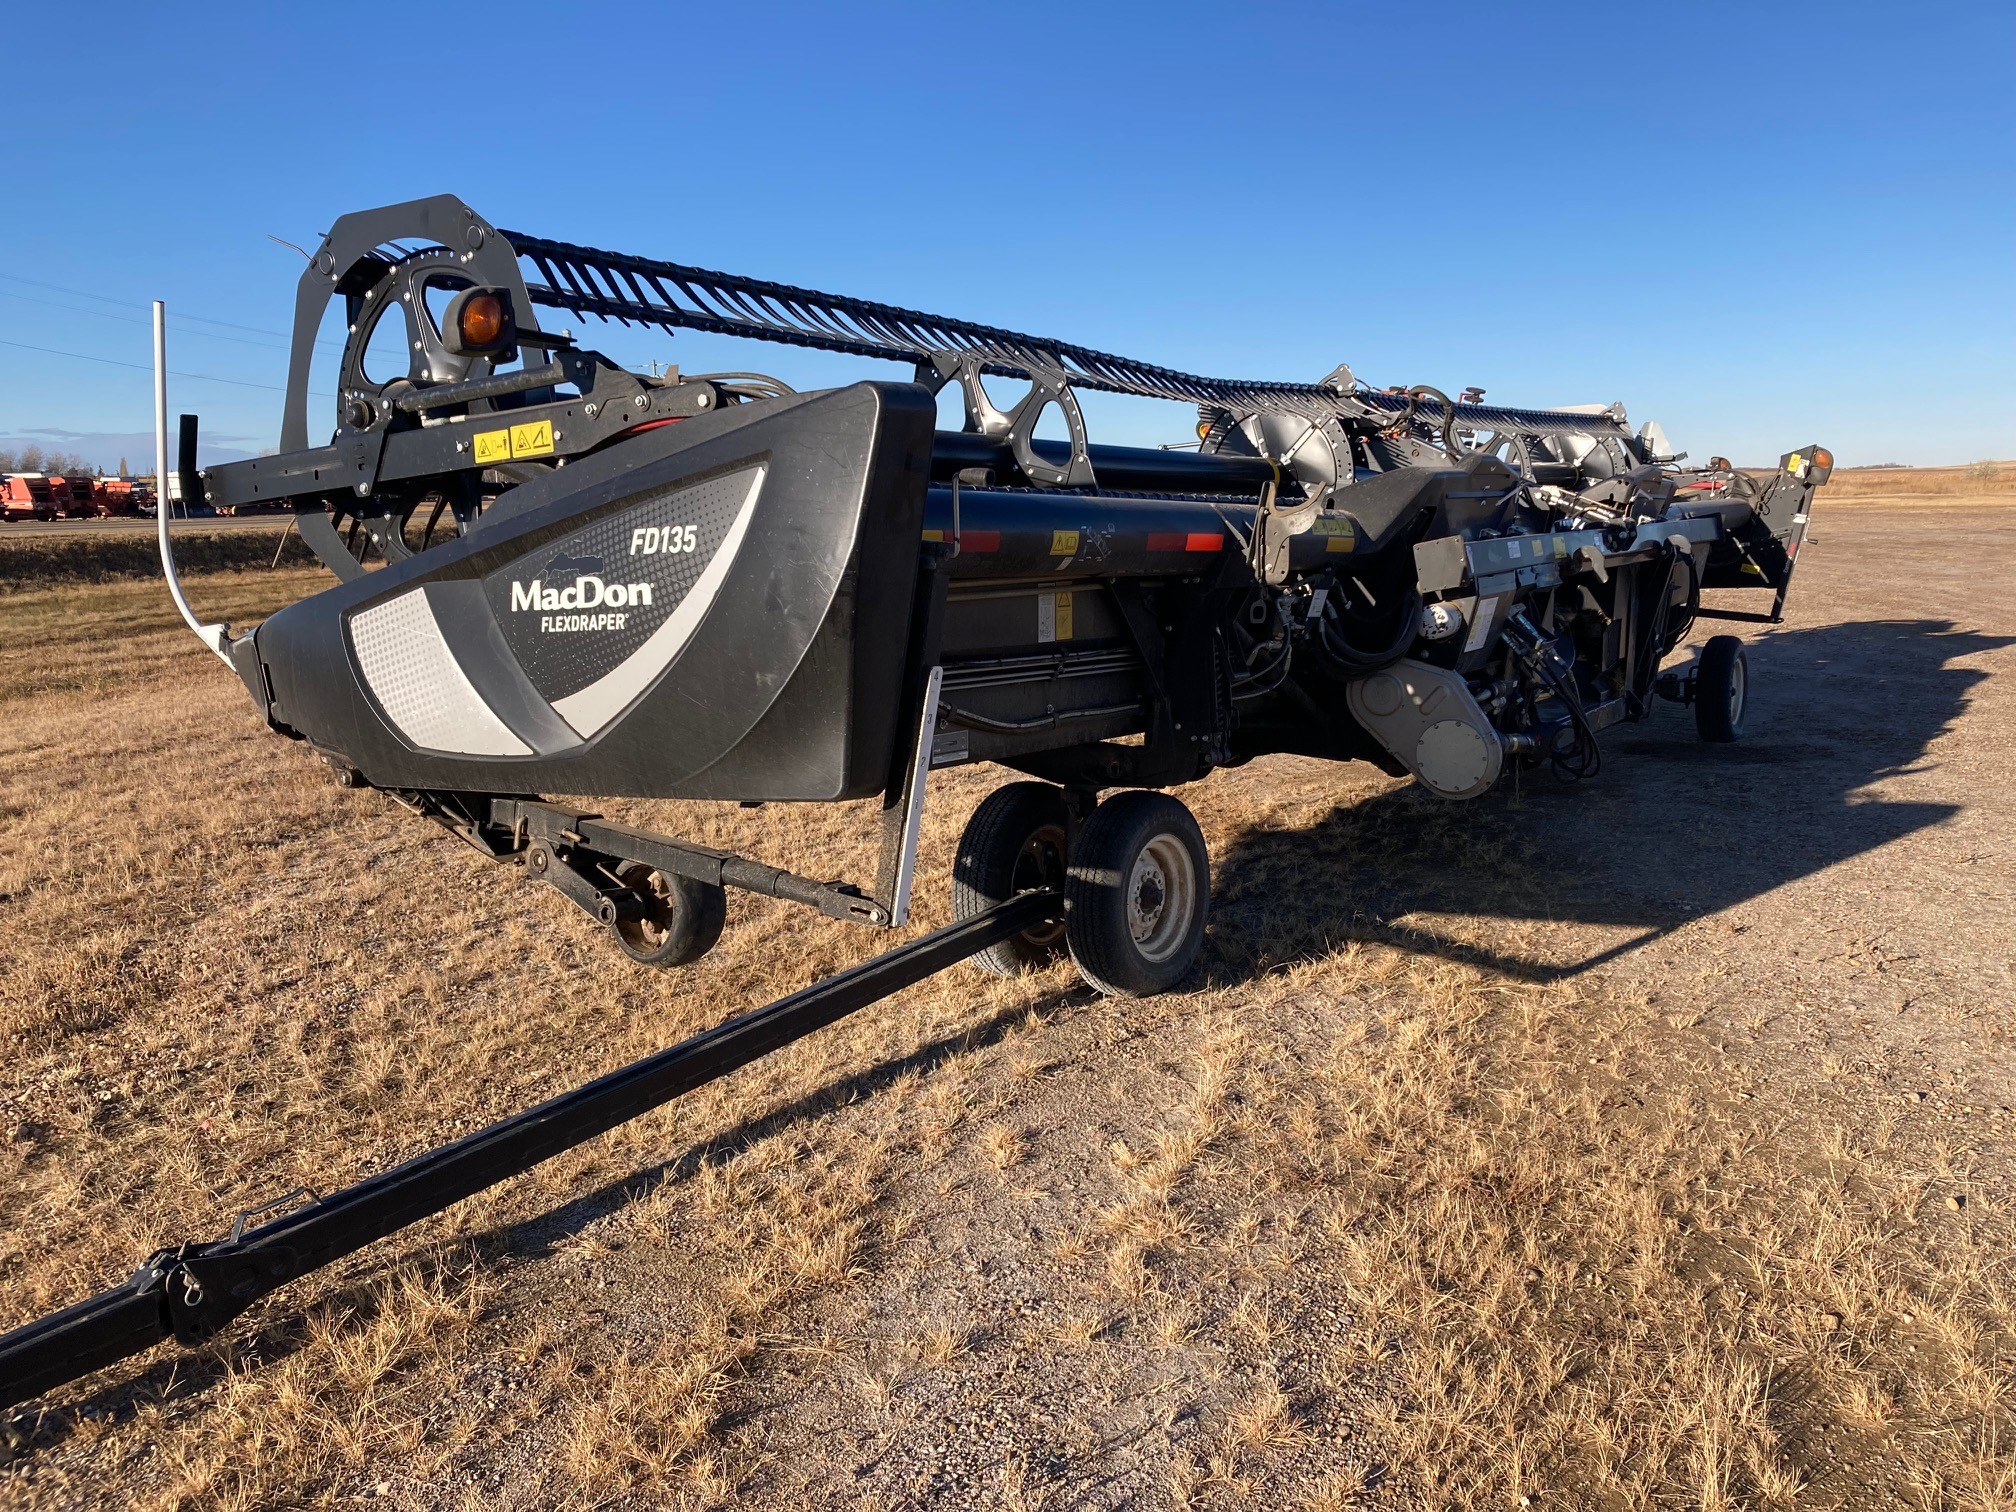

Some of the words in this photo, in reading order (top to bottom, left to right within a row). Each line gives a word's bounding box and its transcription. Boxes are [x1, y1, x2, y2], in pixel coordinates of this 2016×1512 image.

[630, 525, 698, 555] FD135
[511, 576, 653, 612] MacDon
[541, 615, 627, 633] FLEXDRAPER
[933, 670, 939, 682] 4
[927, 713, 933, 725] 3
[920, 756, 926, 767] 2
